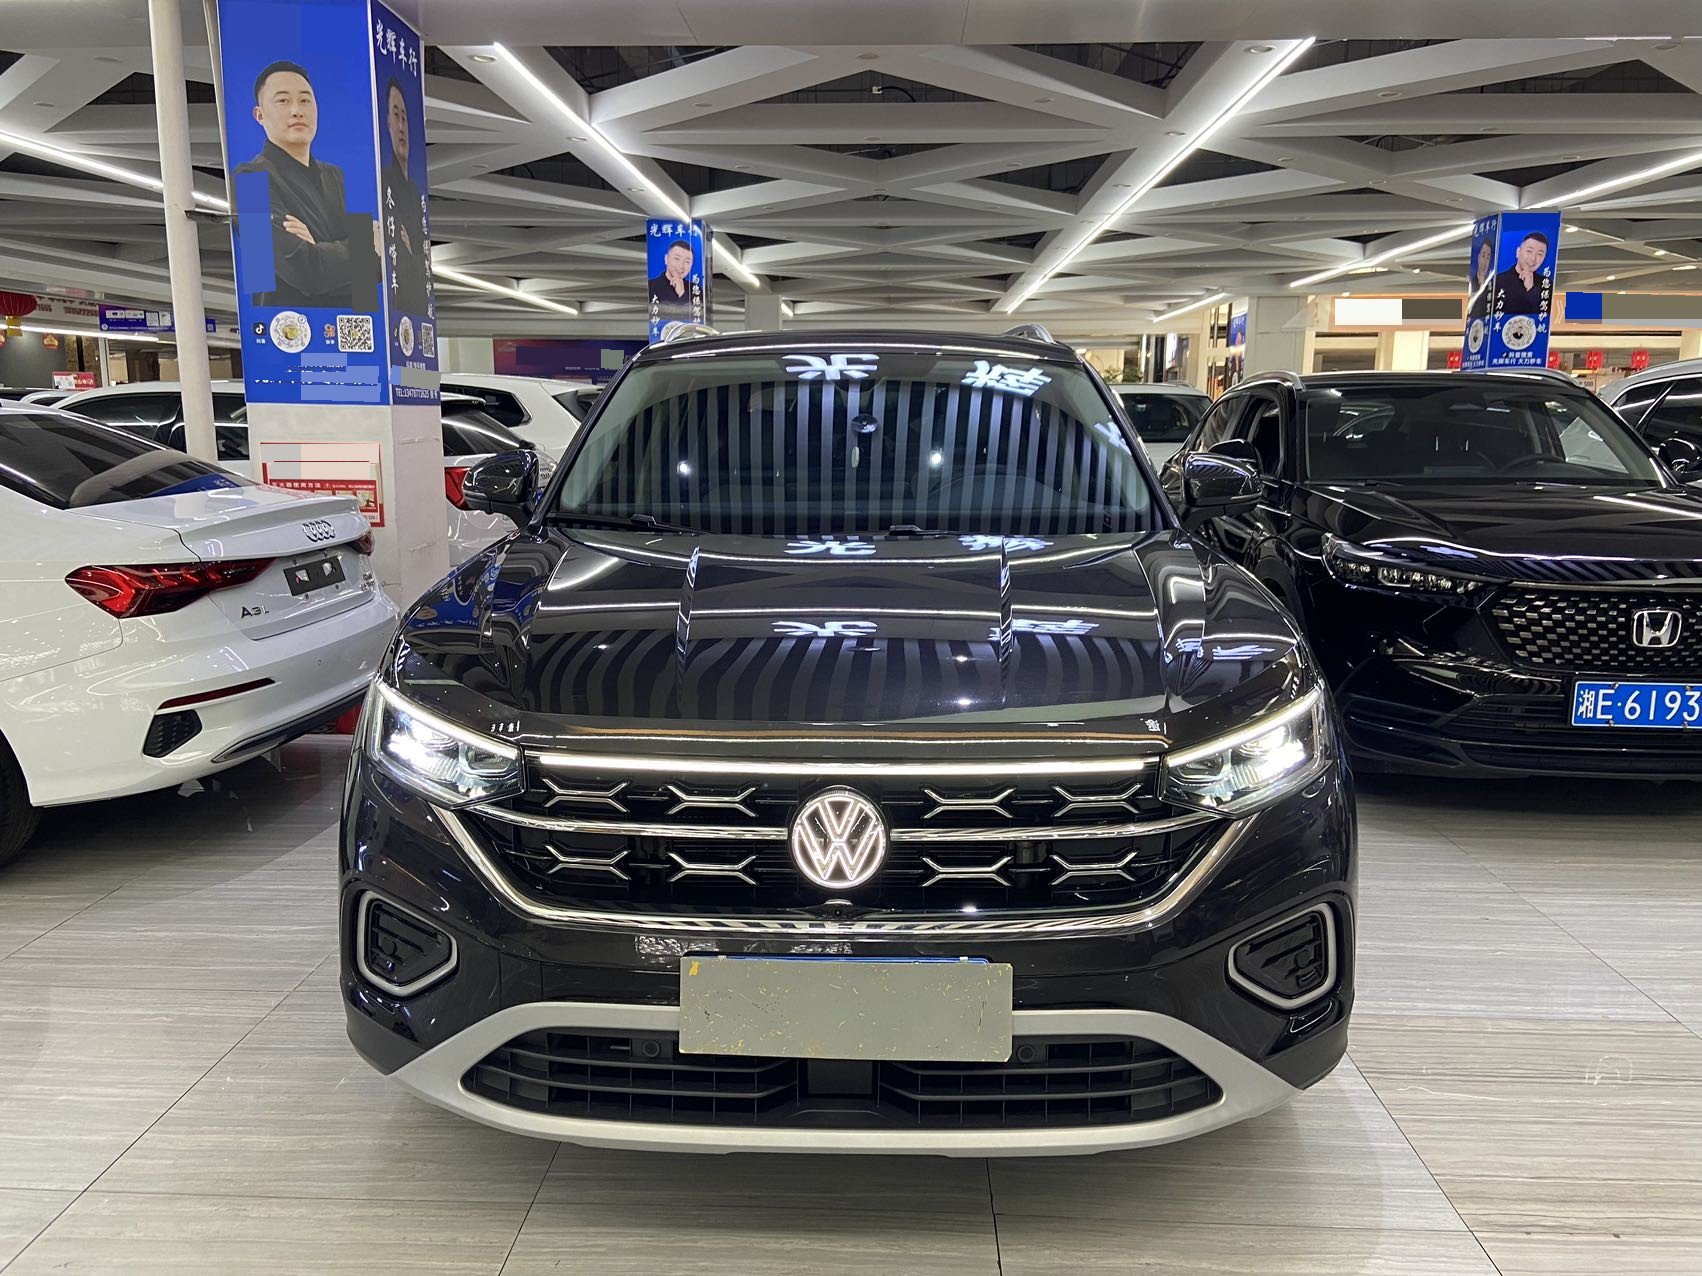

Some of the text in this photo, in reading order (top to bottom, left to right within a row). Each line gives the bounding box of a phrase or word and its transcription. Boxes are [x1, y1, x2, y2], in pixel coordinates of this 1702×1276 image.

[376, 19, 418, 77] 光辉车行
[650, 223, 702, 238] 光辉车行
